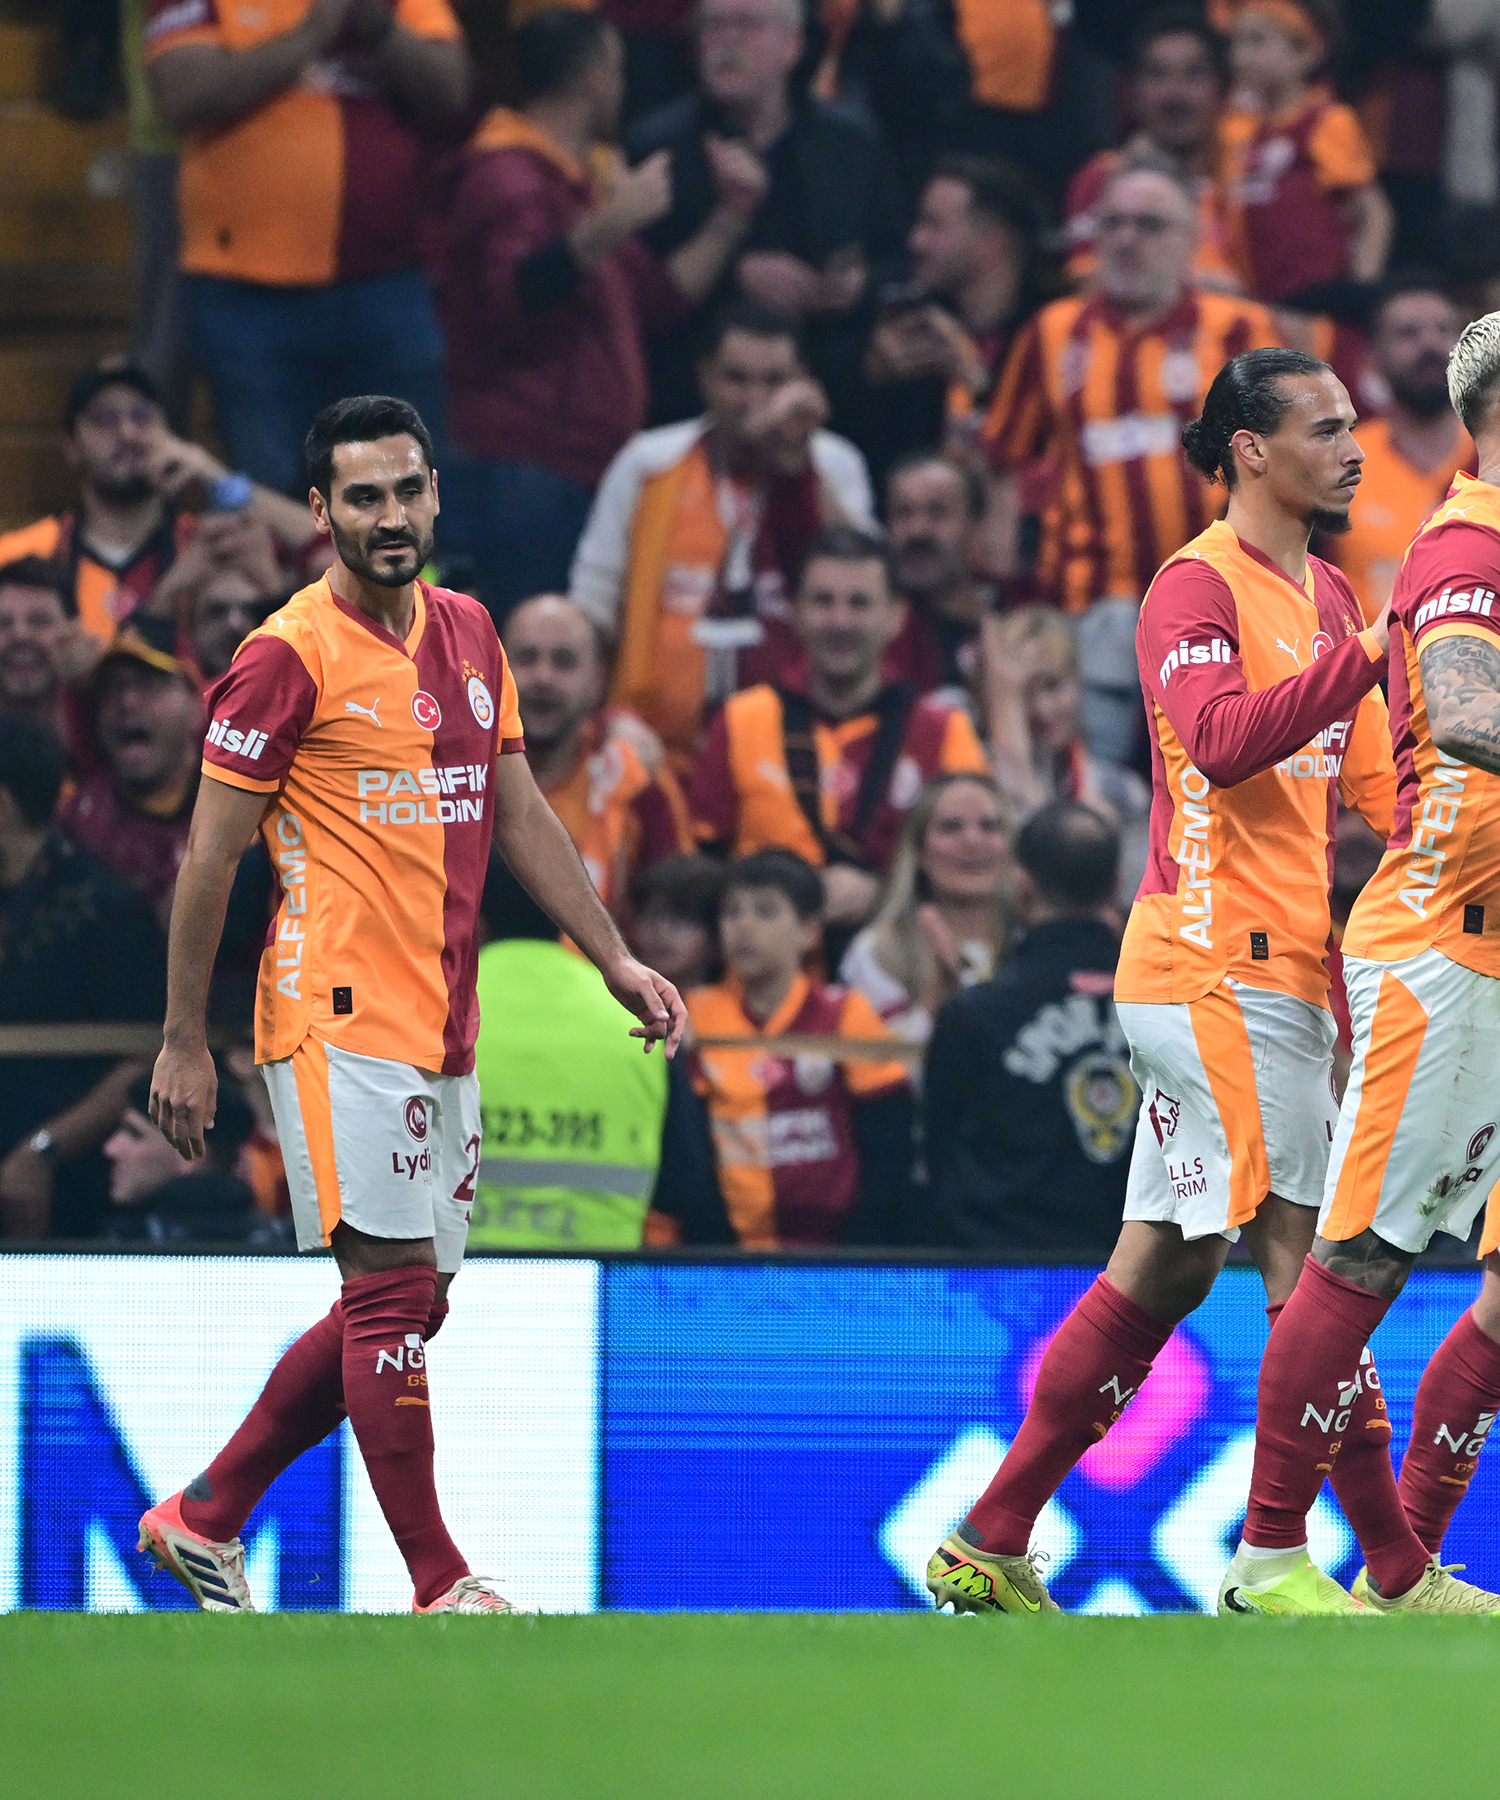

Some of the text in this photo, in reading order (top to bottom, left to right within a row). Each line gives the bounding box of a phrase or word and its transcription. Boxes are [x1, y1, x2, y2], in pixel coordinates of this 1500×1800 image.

[1414, 587, 1495, 634] misli
[1159, 638, 1231, 689] misli
[360, 798, 484, 825] HOLDiN
[1178, 766, 1214, 950] ALFEMO
[276, 812, 307, 1001] ALFEMO
[392, 1146, 431, 1181] Lydi
[1169, 1156, 1204, 1182] LLS
[375, 1345, 425, 1375] NG
[1300, 1402, 1352, 1434] NG
[1433, 1422, 1487, 1457] NG
